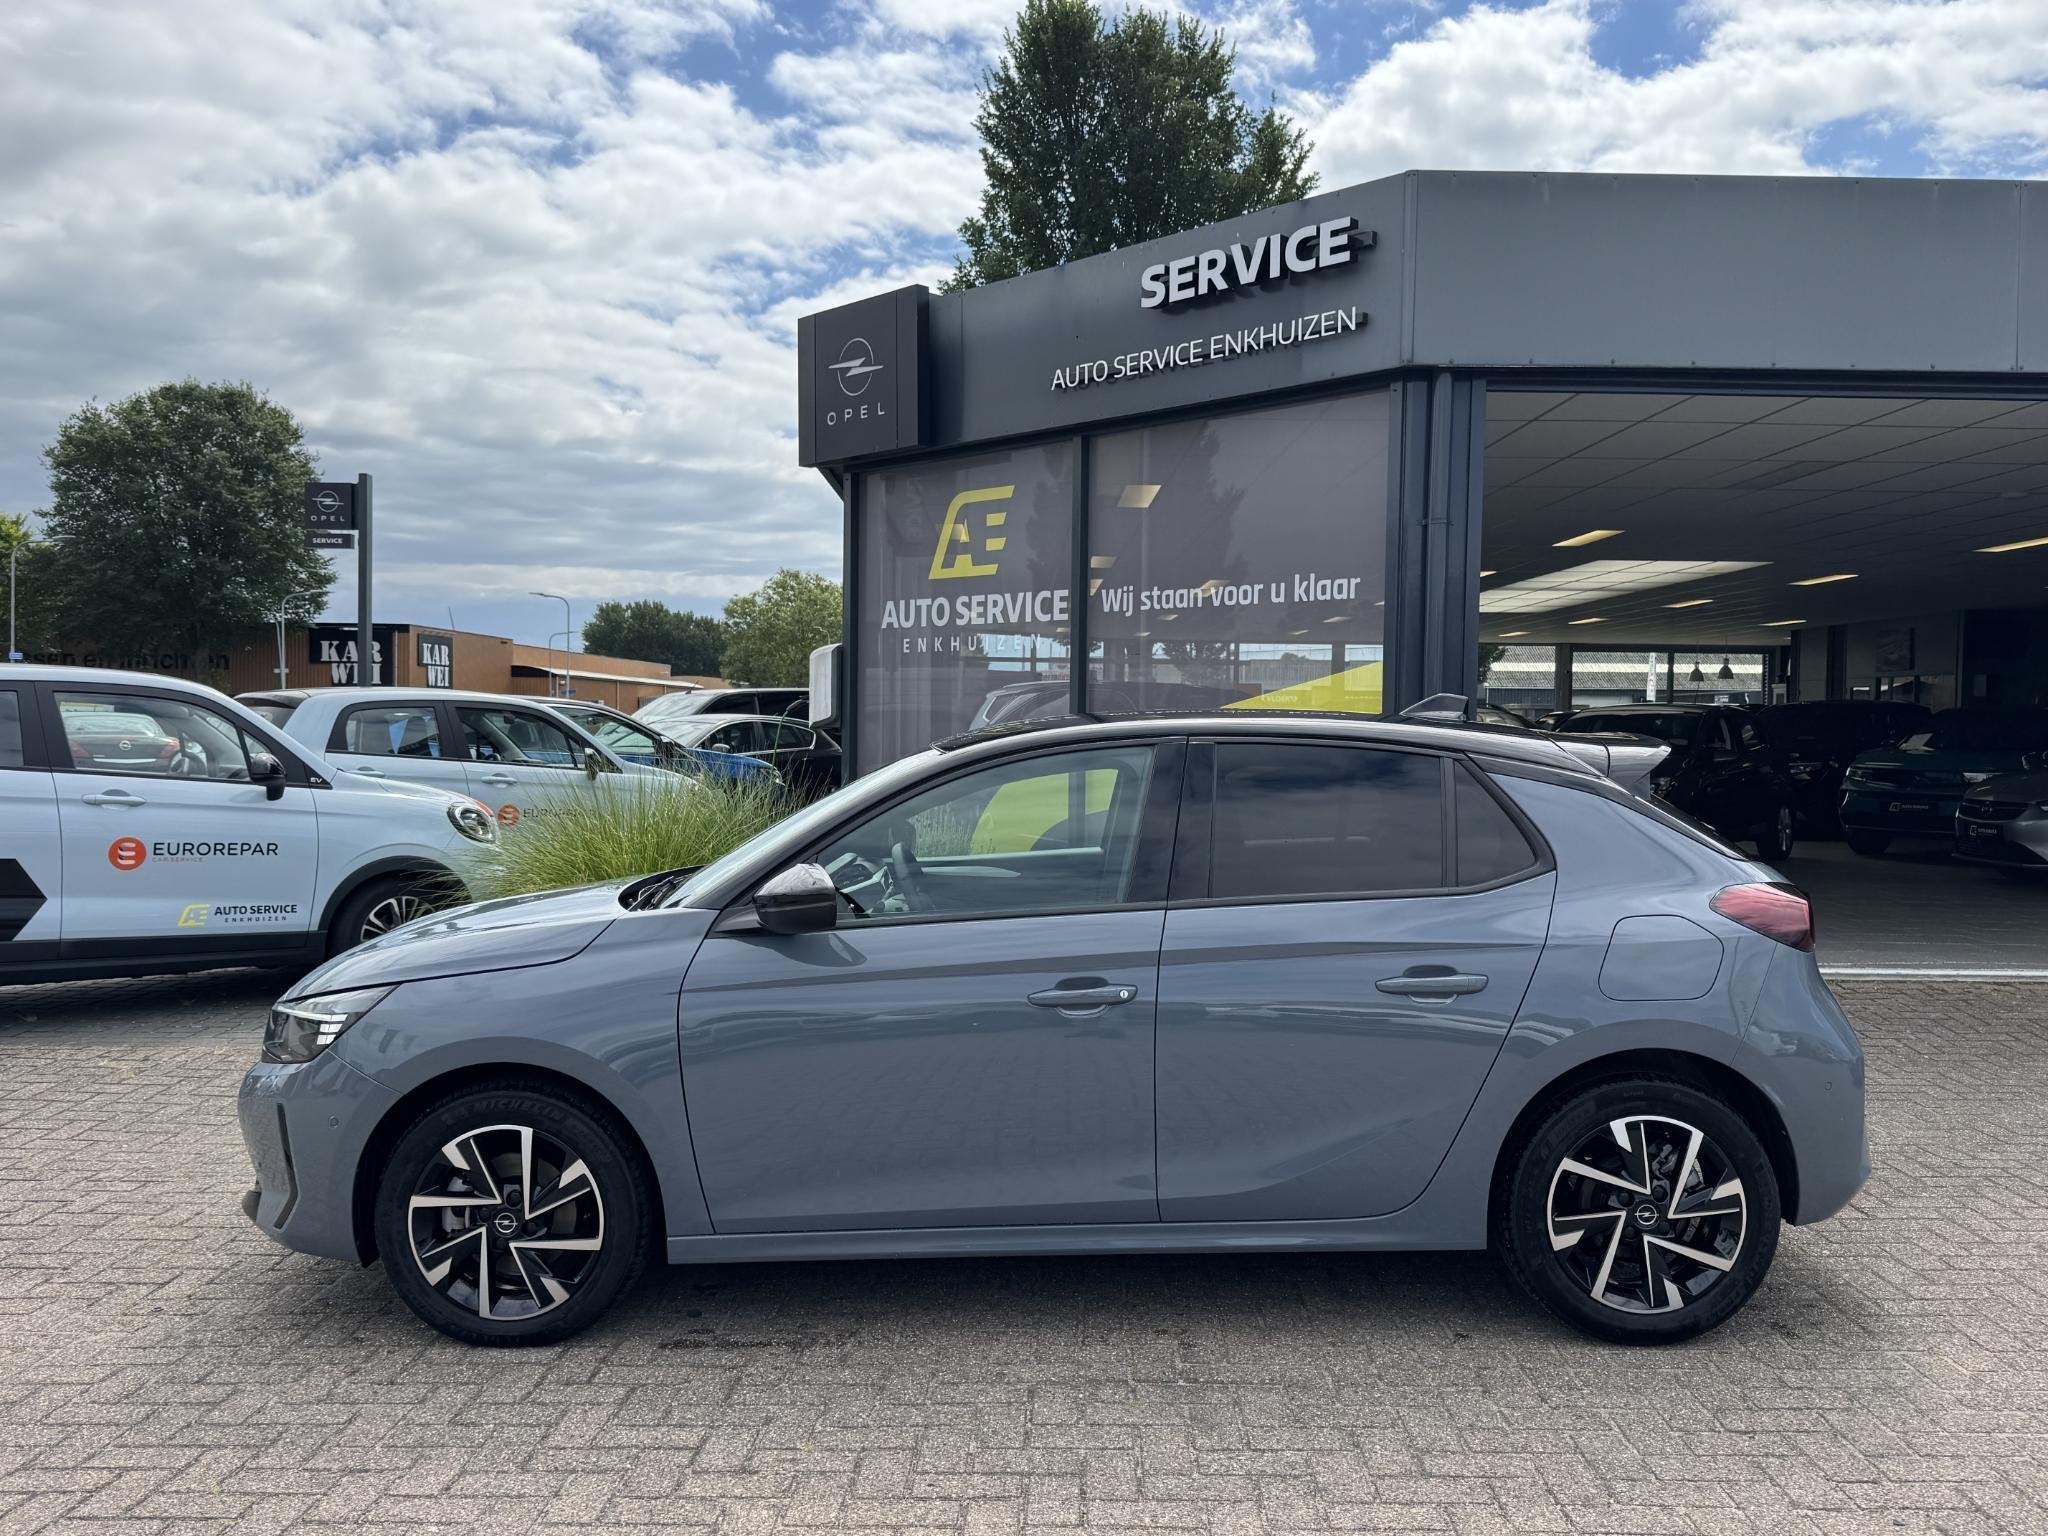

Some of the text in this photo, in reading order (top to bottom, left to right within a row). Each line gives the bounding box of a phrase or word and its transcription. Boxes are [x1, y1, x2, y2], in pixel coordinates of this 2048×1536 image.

[1141, 216, 1352, 309] SERVICE
[1051, 306, 1357, 391] AUTO SERVICE ENKHUIZEN
[826, 402, 885, 426] OPEL
[1101, 573, 1361, 617] Wij staan voor u klaar
[881, 589, 1069, 629] AUTO SERVICE
[422, 643, 449, 666] KAR
[903, 633, 1042, 653] ENKHUIZEN
[427, 665, 449, 687] WEI
[152, 842, 279, 856] EUROREPAR
[214, 904, 298, 916] AUTO SERVICE
